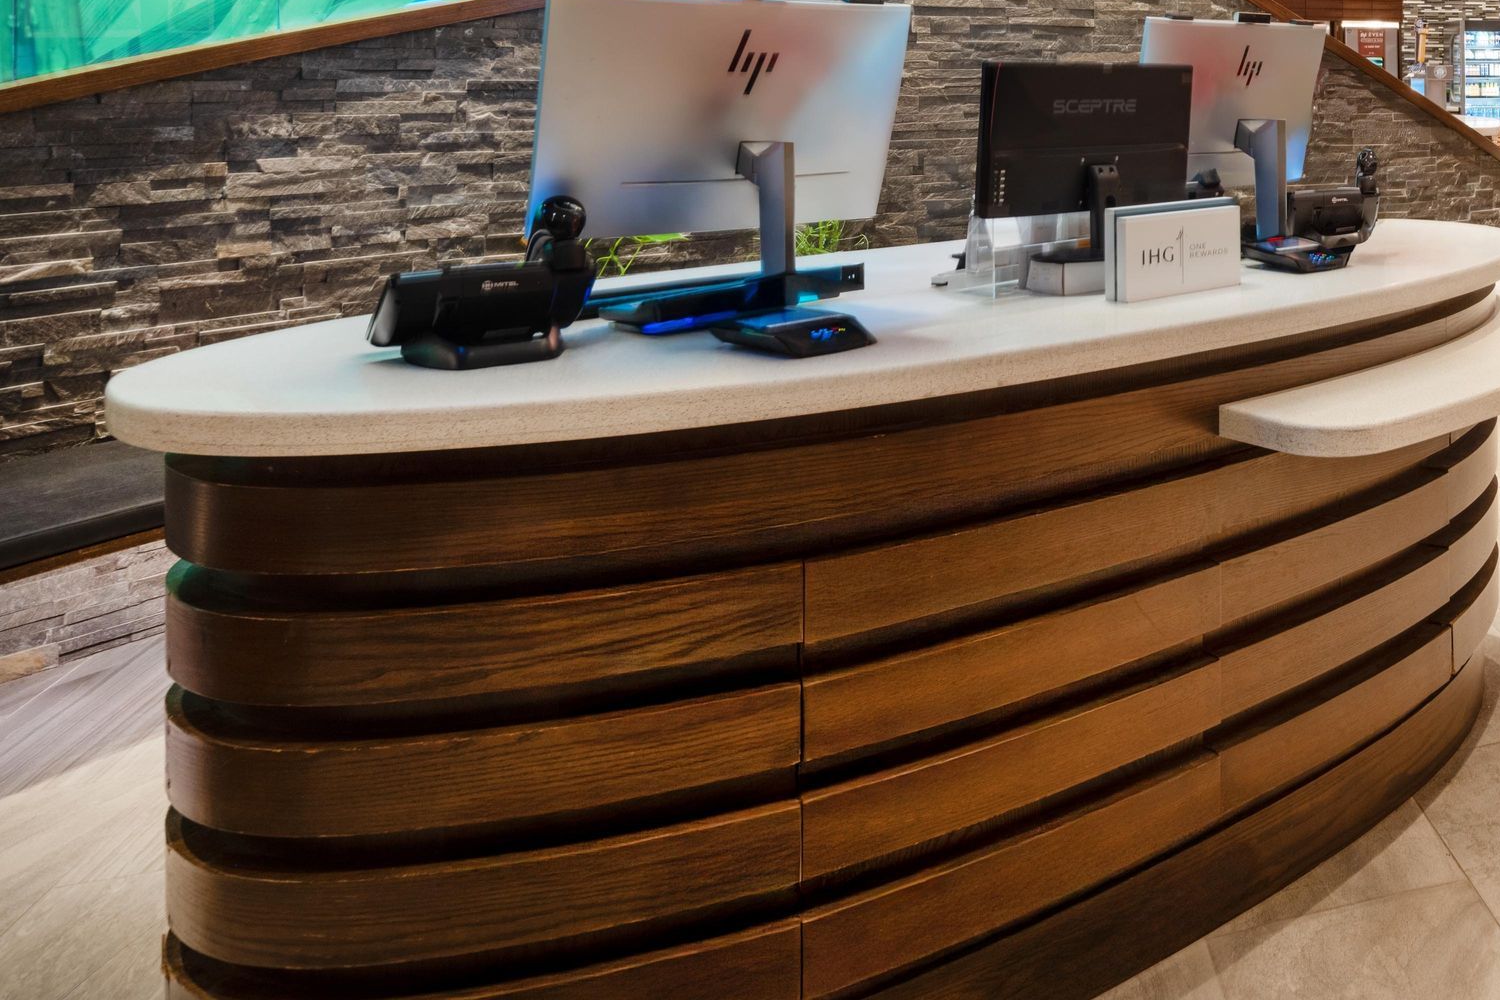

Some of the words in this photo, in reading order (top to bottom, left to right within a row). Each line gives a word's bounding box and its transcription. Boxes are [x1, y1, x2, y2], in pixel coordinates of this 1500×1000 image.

[727, 29, 780, 95] hp
[1236, 45, 1263, 86] hp
[1053, 99, 1137, 113] SCEPTRE
[1189, 242, 1206, 251] ONE
[1189, 247, 1229, 259] REWARDS
[1142, 246, 1174, 266] IHG
